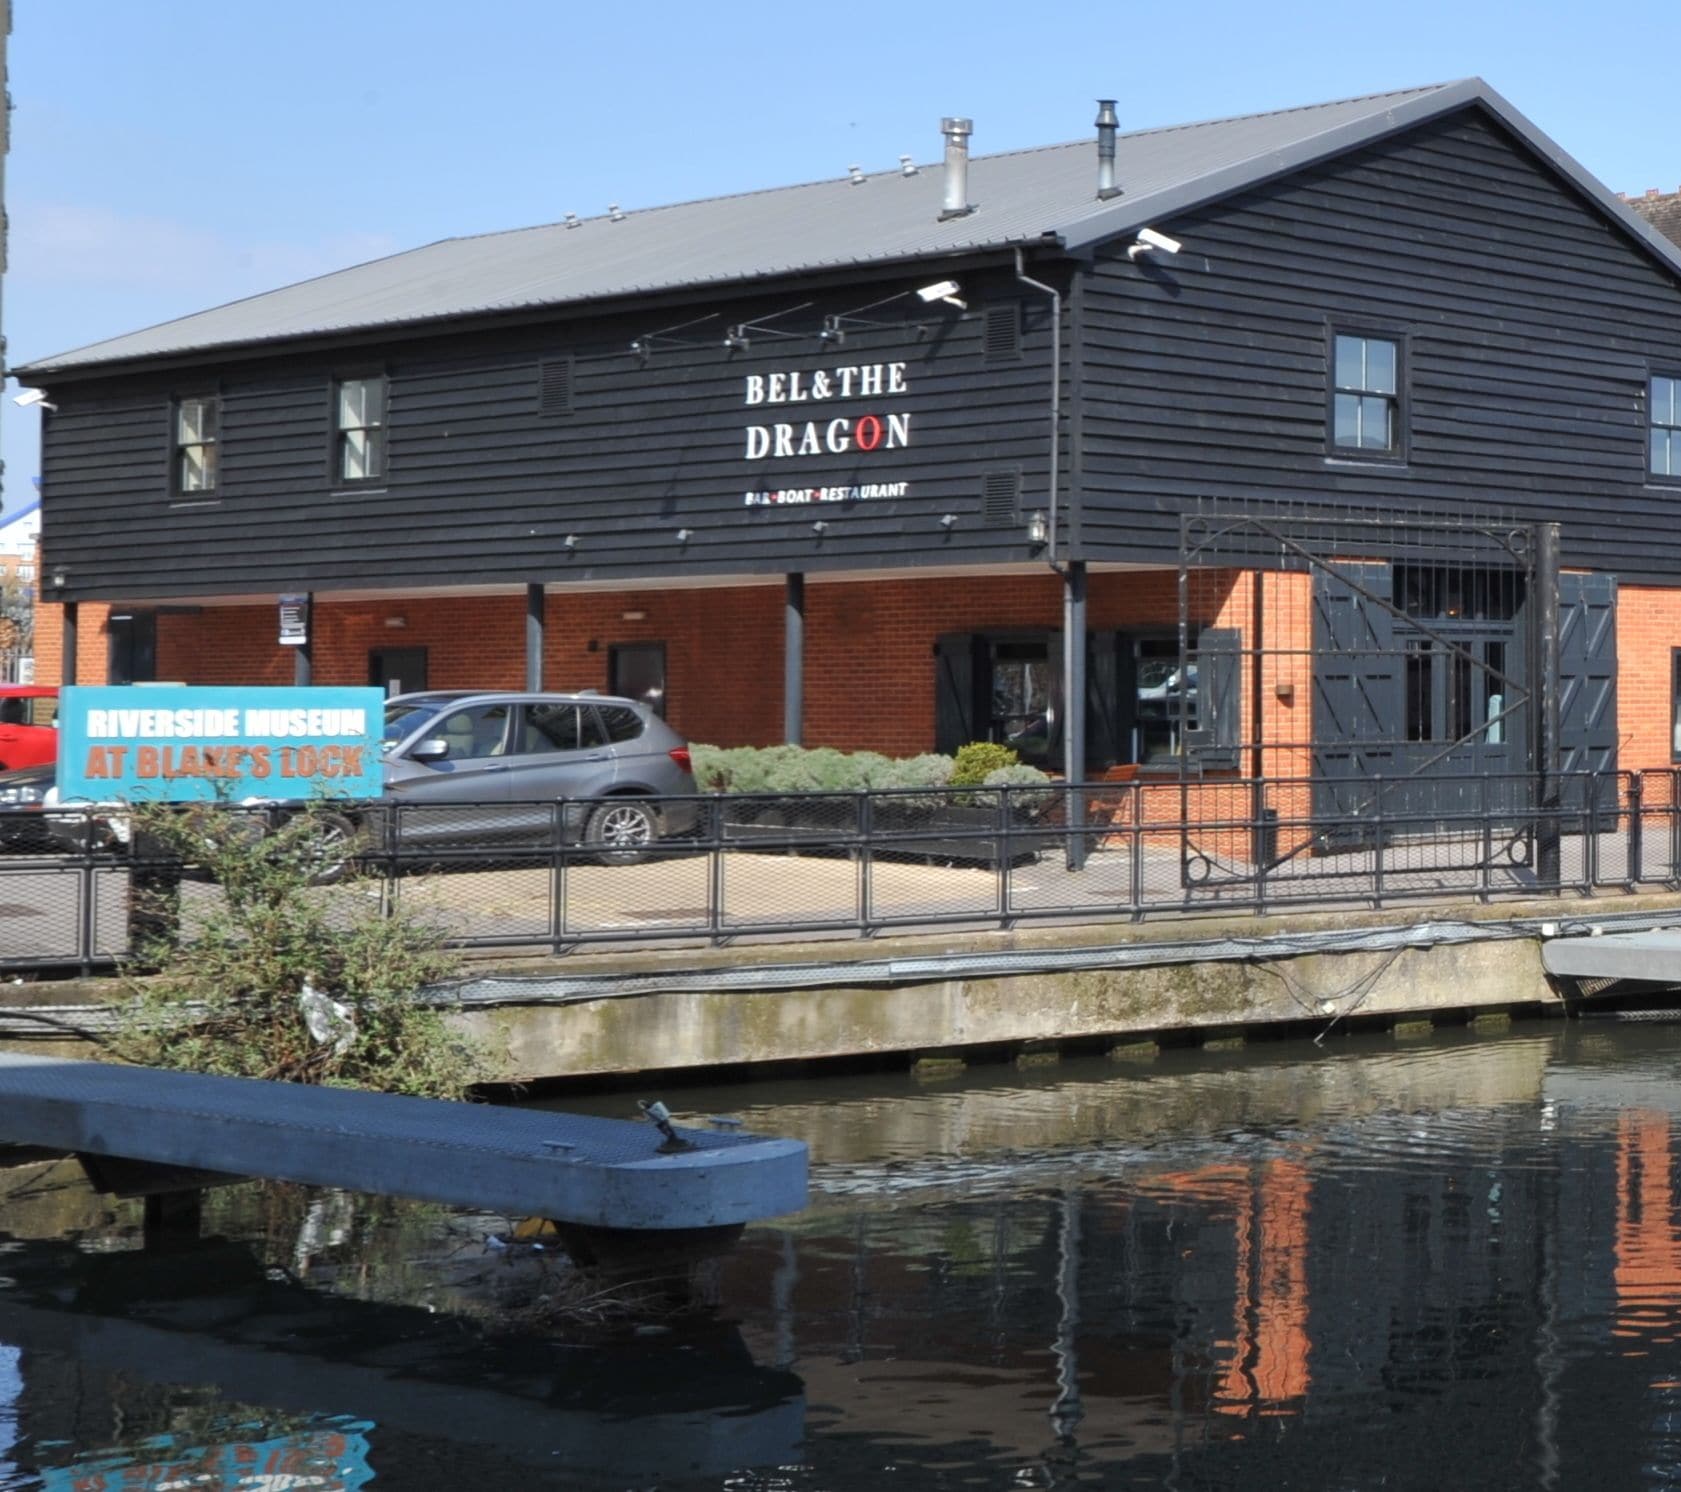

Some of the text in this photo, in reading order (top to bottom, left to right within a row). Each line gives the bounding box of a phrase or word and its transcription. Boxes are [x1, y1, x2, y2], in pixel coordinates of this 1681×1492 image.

[745, 413, 911, 459] DRAGON
[777, 489, 814, 504] BOAT
[819, 482, 908, 501] RESTAURANT
[86, 708, 367, 738] RIVERSIDE MUSEUM
[85, 745, 363, 779] AT BLAKE'S LOCK
